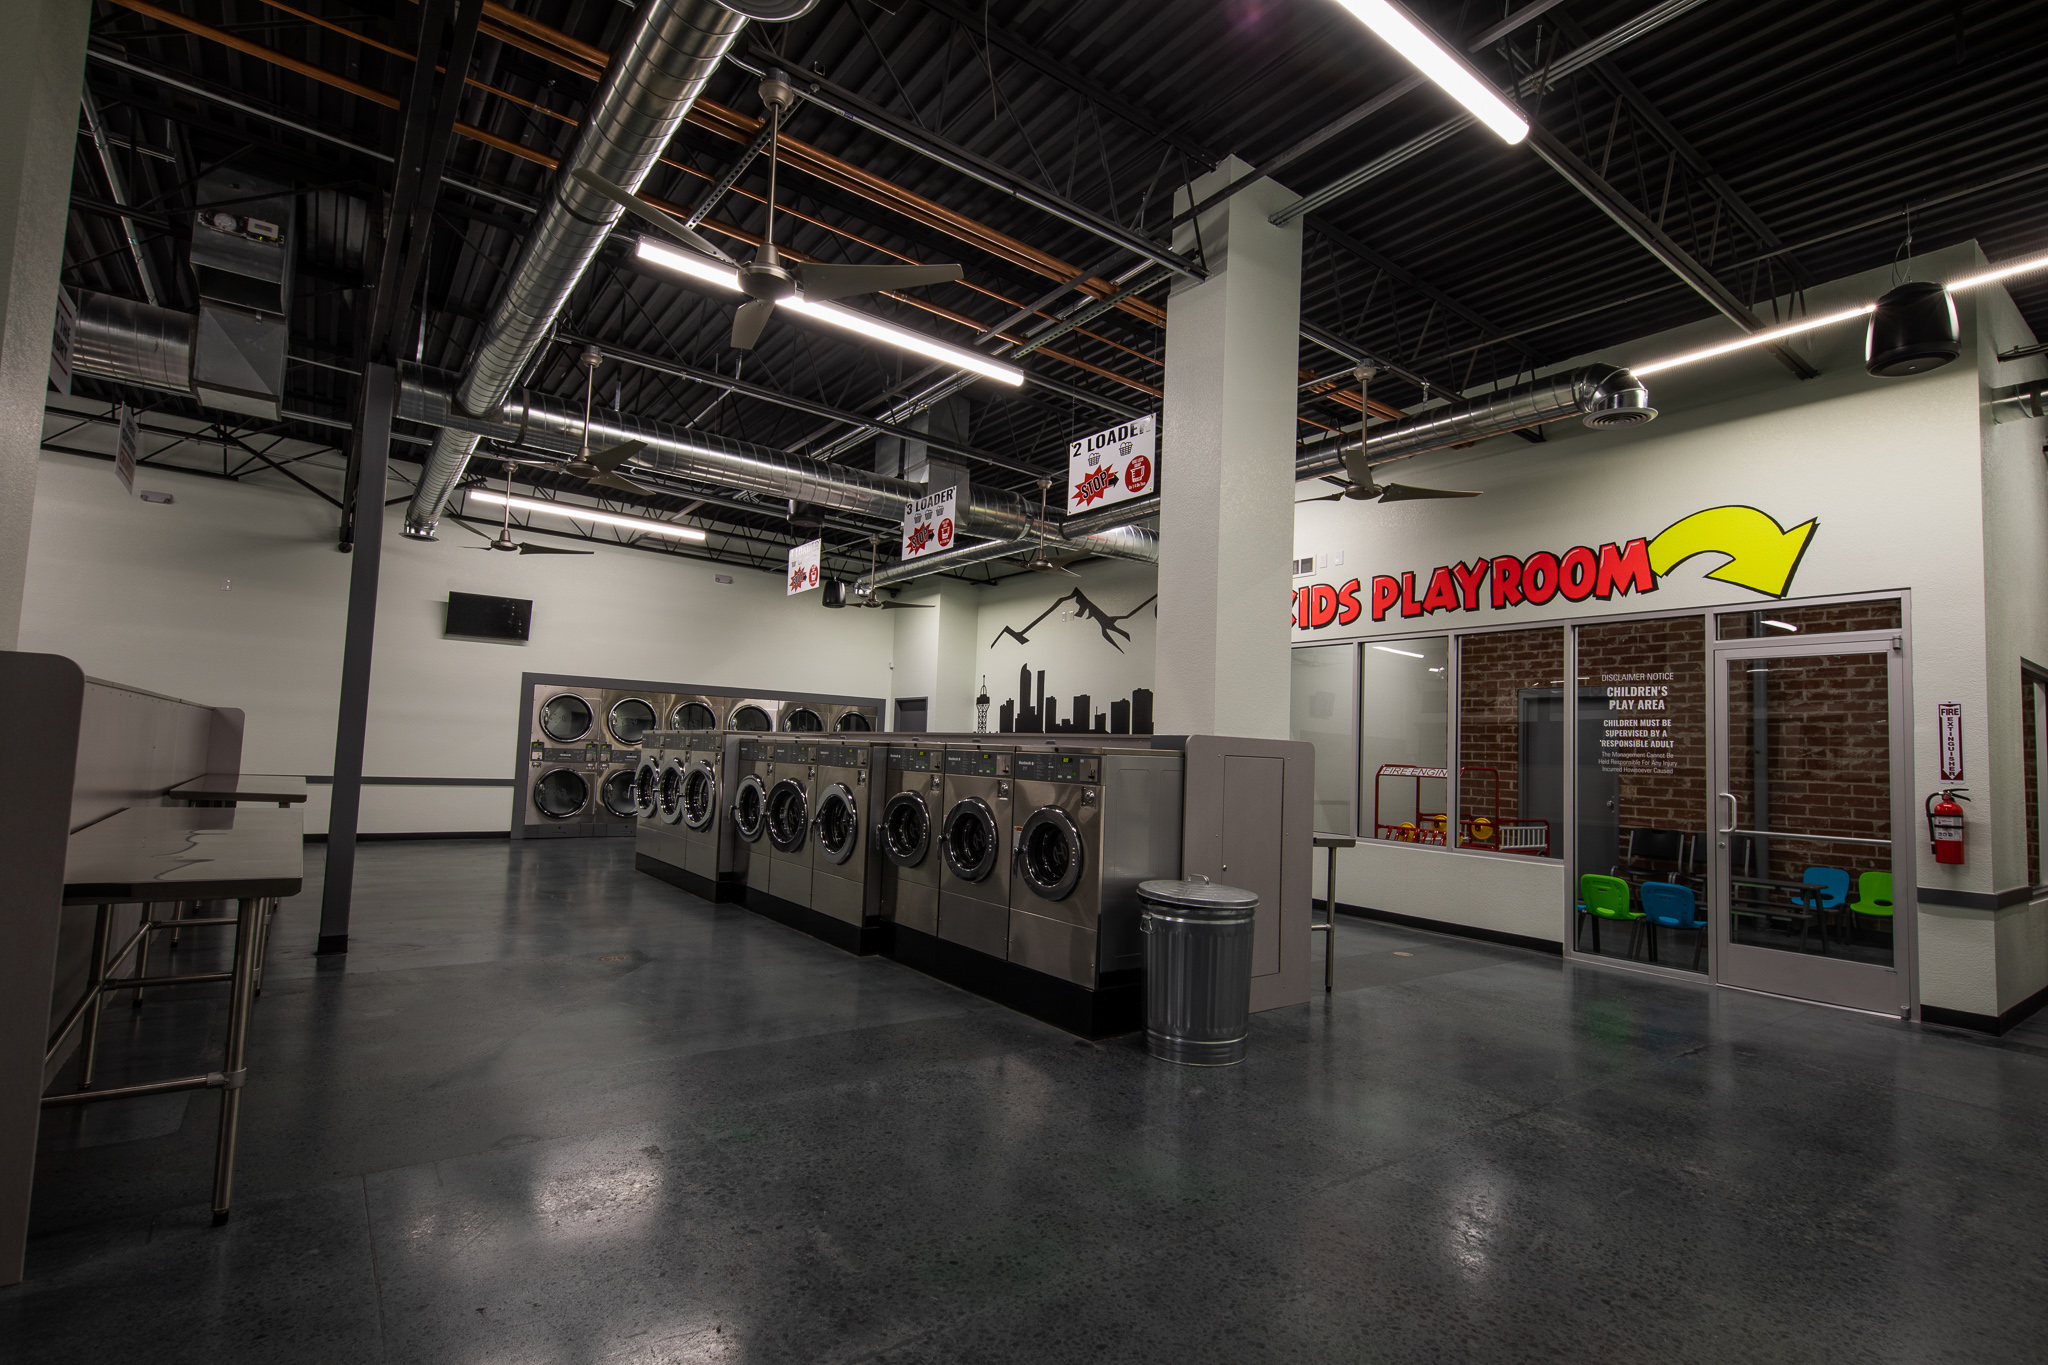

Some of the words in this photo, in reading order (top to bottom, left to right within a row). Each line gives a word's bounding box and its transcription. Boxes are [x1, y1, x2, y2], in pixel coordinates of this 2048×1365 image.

[1073, 442, 1082, 458] 2
[1087, 417, 1151, 453] LOADE
[1081, 471, 1107, 499] STOP
[906, 503, 913, 515] 3
[915, 488, 954, 512] LOADER
[911, 527, 928, 549] STOP
[1371, 537, 1659, 622] PLAYROOM
[1601, 673, 1645, 682] DISCLAIMER
[1646, 672, 1674, 680] NOTICE
[1606, 685, 1668, 697] CHILDREN'S
[1609, 699, 1635, 710] PLAY
[1637, 699, 1665, 710] AREA
[1940, 708, 1959, 716] FIRE
[1603, 719, 1638, 727] CHILDREN
[1640, 719, 1660, 727] MUST
[1661, 718, 1672, 727] BE
[1605, 729, 1648, 738] SUPERVISED
[1650, 729, 1660, 737] BY
[1662, 729, 1668, 737] A
[1601, 739, 1649, 748] RESPONSIBLE
[1650, 740, 1674, 748] ADULT
[1947, 716, 1955, 776] EXTINGUISHER
[1662, 760, 1678, 768] Injury
[1382, 767, 1408, 775] FIRE
[1410, 768, 1447, 777] ENGIN
